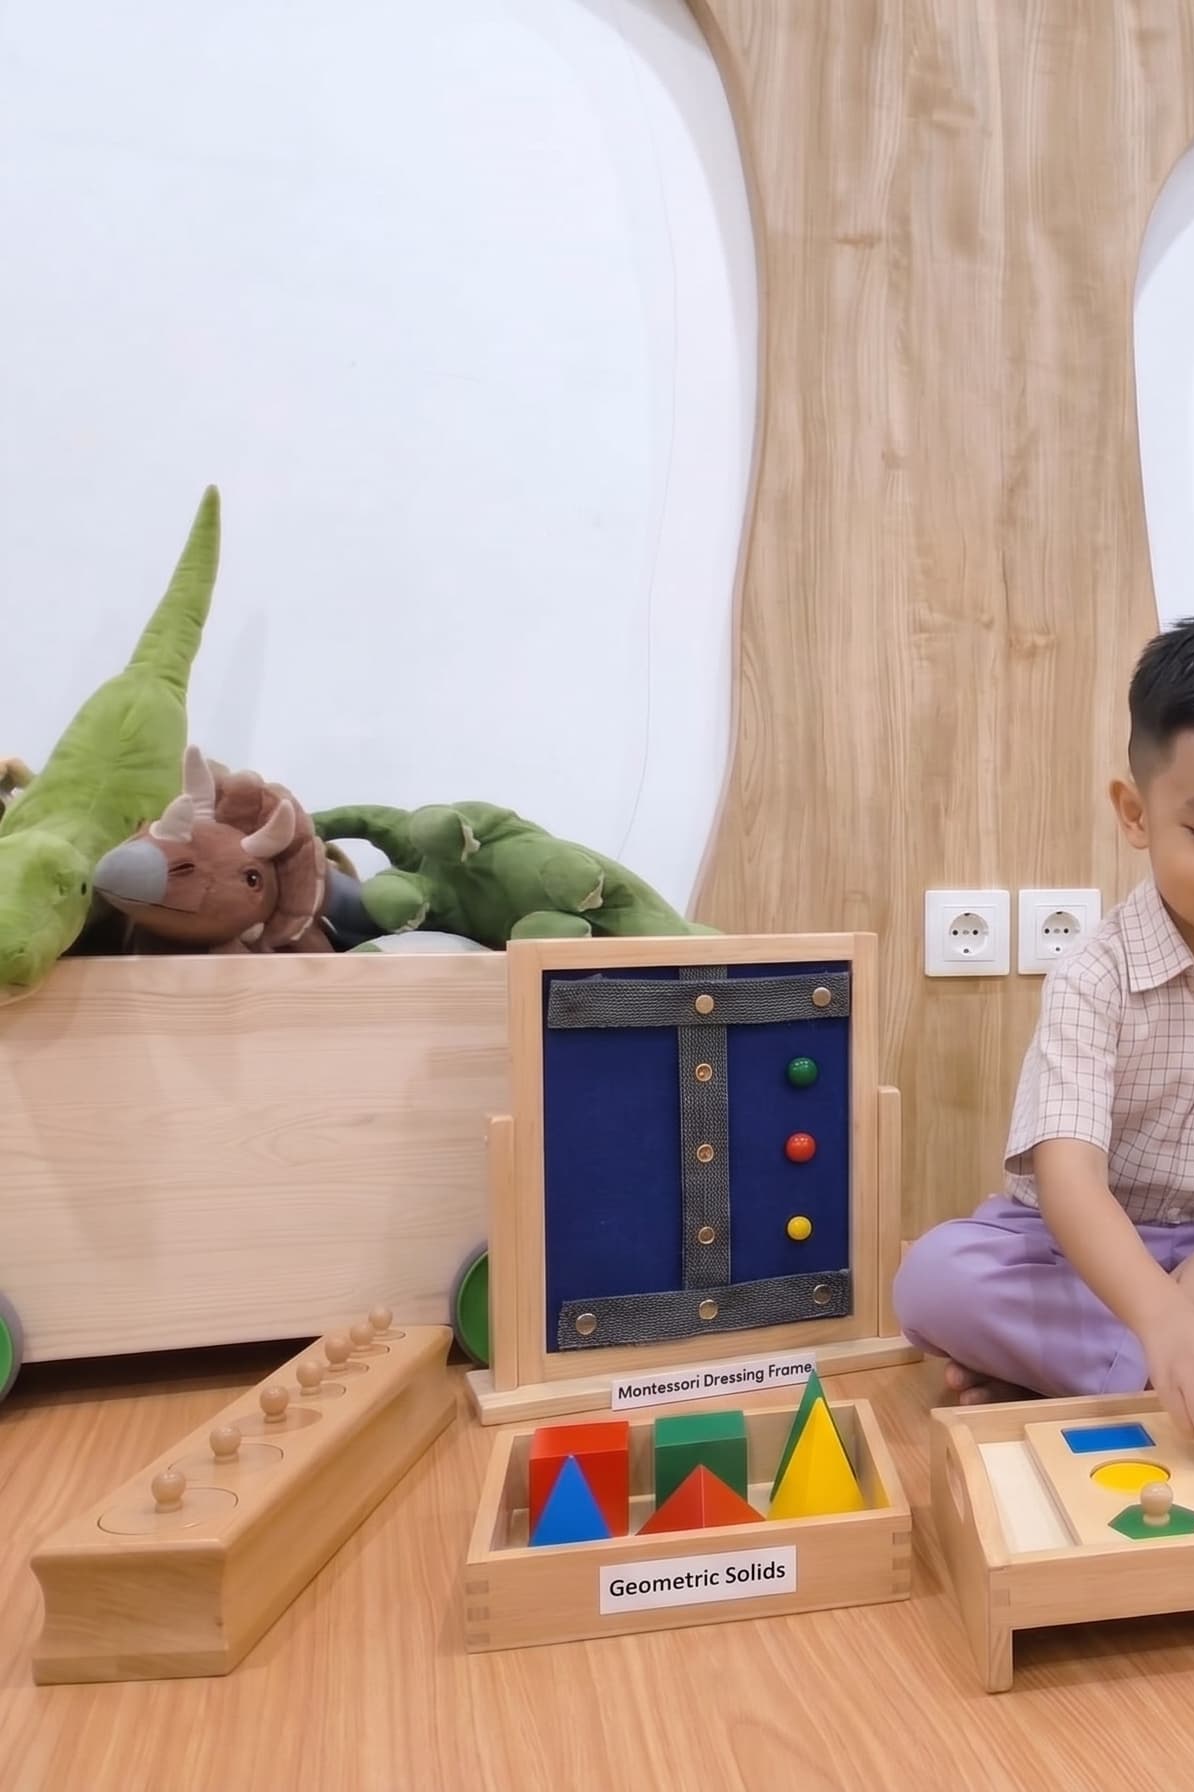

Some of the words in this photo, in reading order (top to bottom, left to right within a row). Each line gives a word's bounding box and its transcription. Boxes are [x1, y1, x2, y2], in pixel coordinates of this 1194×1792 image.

[617, 1374, 700, 1400] Montessori
[703, 1367, 765, 1388] Dressing
[609, 1569, 720, 1597] Geometric
[725, 1561, 786, 1584] Solids
